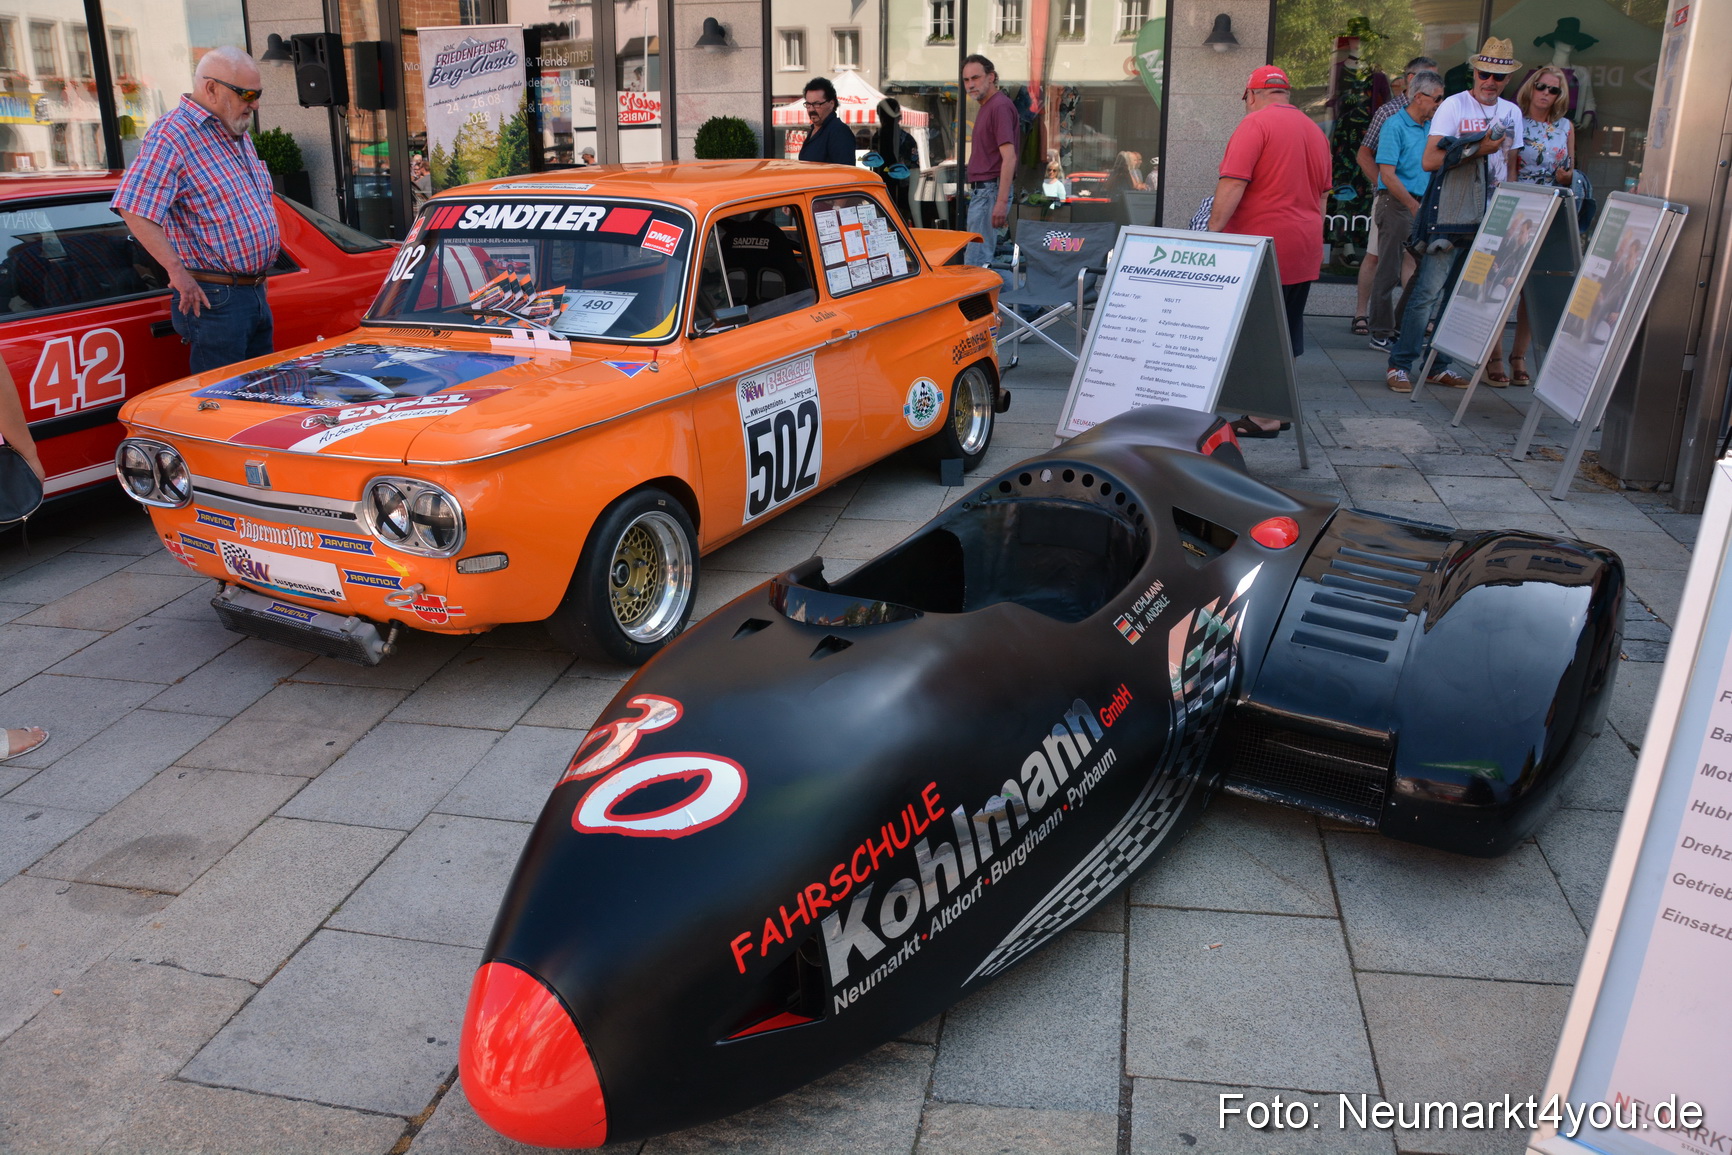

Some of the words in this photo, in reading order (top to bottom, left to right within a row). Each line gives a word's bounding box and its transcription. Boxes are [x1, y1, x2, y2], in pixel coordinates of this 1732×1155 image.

[436, 39, 506, 66] FRIEDENFELSER
[443, 43, 455, 52] ADAC
[429, 52, 517, 88] Berg-Classic
[535, 56, 568, 67] Trends
[538, 103, 570, 113] Trends
[464, 111, 491, 125] 2018
[1461, 119, 1487, 131] LIFE
[458, 204, 607, 231] SANDTLER
[648, 230, 676, 243] DMV
[733, 237, 770, 246] SANDTLER
[1049, 238, 1085, 251] KW
[384, 245, 426, 285] 02
[1171, 250, 1217, 267] DEKRA
[1120, 265, 1241, 285] RENNFAHRZEUGSCHAU
[583, 299, 613, 311] 490
[1158, 320, 1210, 330] 4-Zylinder-Reihenmotor
[30, 327, 126, 416] 42
[1144, 364, 1172, 372] Renngetriebe
[745, 382, 764, 403] KW
[1135, 393, 1170, 402] veranstaltungen
[748, 400, 818, 516] 502
[200, 513, 233, 527] RAVENOL
[238, 517, 314, 550] Jägermeister
[183, 536, 213, 551] RAVENOL
[324, 538, 367, 551] RAVENOL
[232, 555, 271, 582] KW
[274, 577, 342, 597] suspensions.de
[350, 574, 396, 587] RAVENOL
[1124, 612, 1137, 623] B.
[1131, 579, 1164, 615] KOHLMANN
[273, 604, 310, 620] RAVENOL
[1135, 621, 1148, 633] W.
[1145, 594, 1170, 624] ANDERLE
[820, 698, 1104, 987] Kohlmann
[1100, 683, 1133, 727] GmbH
[1681, 836, 1732, 861] Drehz
[730, 781, 945, 974] FAHRSCHULE
[833, 932, 921, 1015] Neumarkt
[929, 876, 984, 941] Altdorf
[990, 807, 1063, 886] Burgthann
[1066, 747, 1117, 811] Pyrbaum
